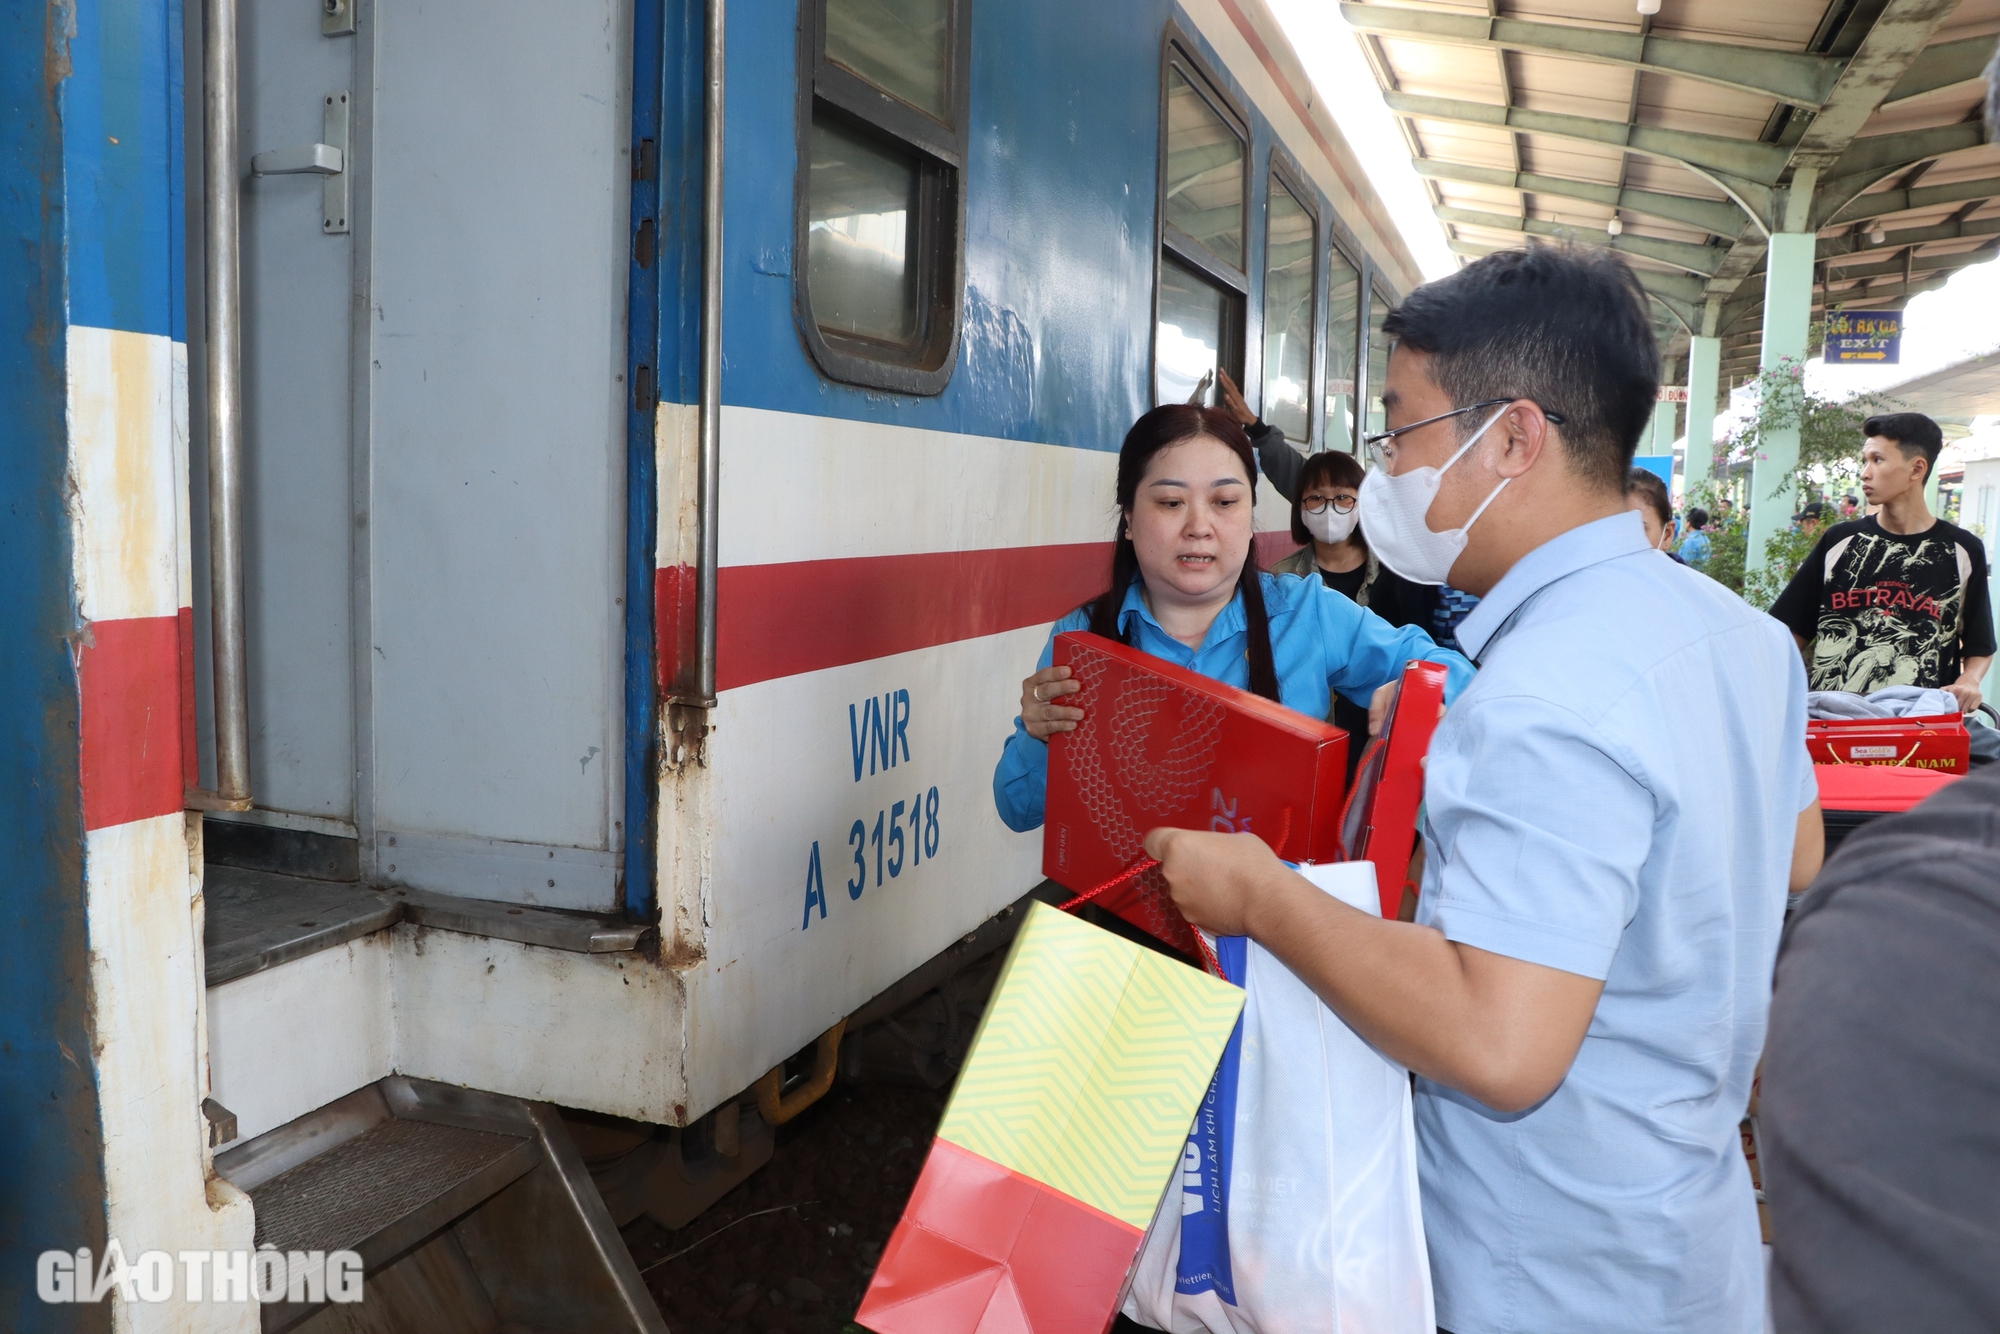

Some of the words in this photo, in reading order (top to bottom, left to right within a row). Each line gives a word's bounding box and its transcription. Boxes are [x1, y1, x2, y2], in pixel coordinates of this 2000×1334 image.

[1840, 338, 1890, 348] EXIT
[1831, 588, 1943, 621] BETRAYAL
[848, 688, 910, 783] VNR
[1916, 757, 1956, 769] NAM
[802, 840, 827, 931] A
[847, 785, 940, 901] 31518
[1204, 1107, 1216, 1136] KHÍ
